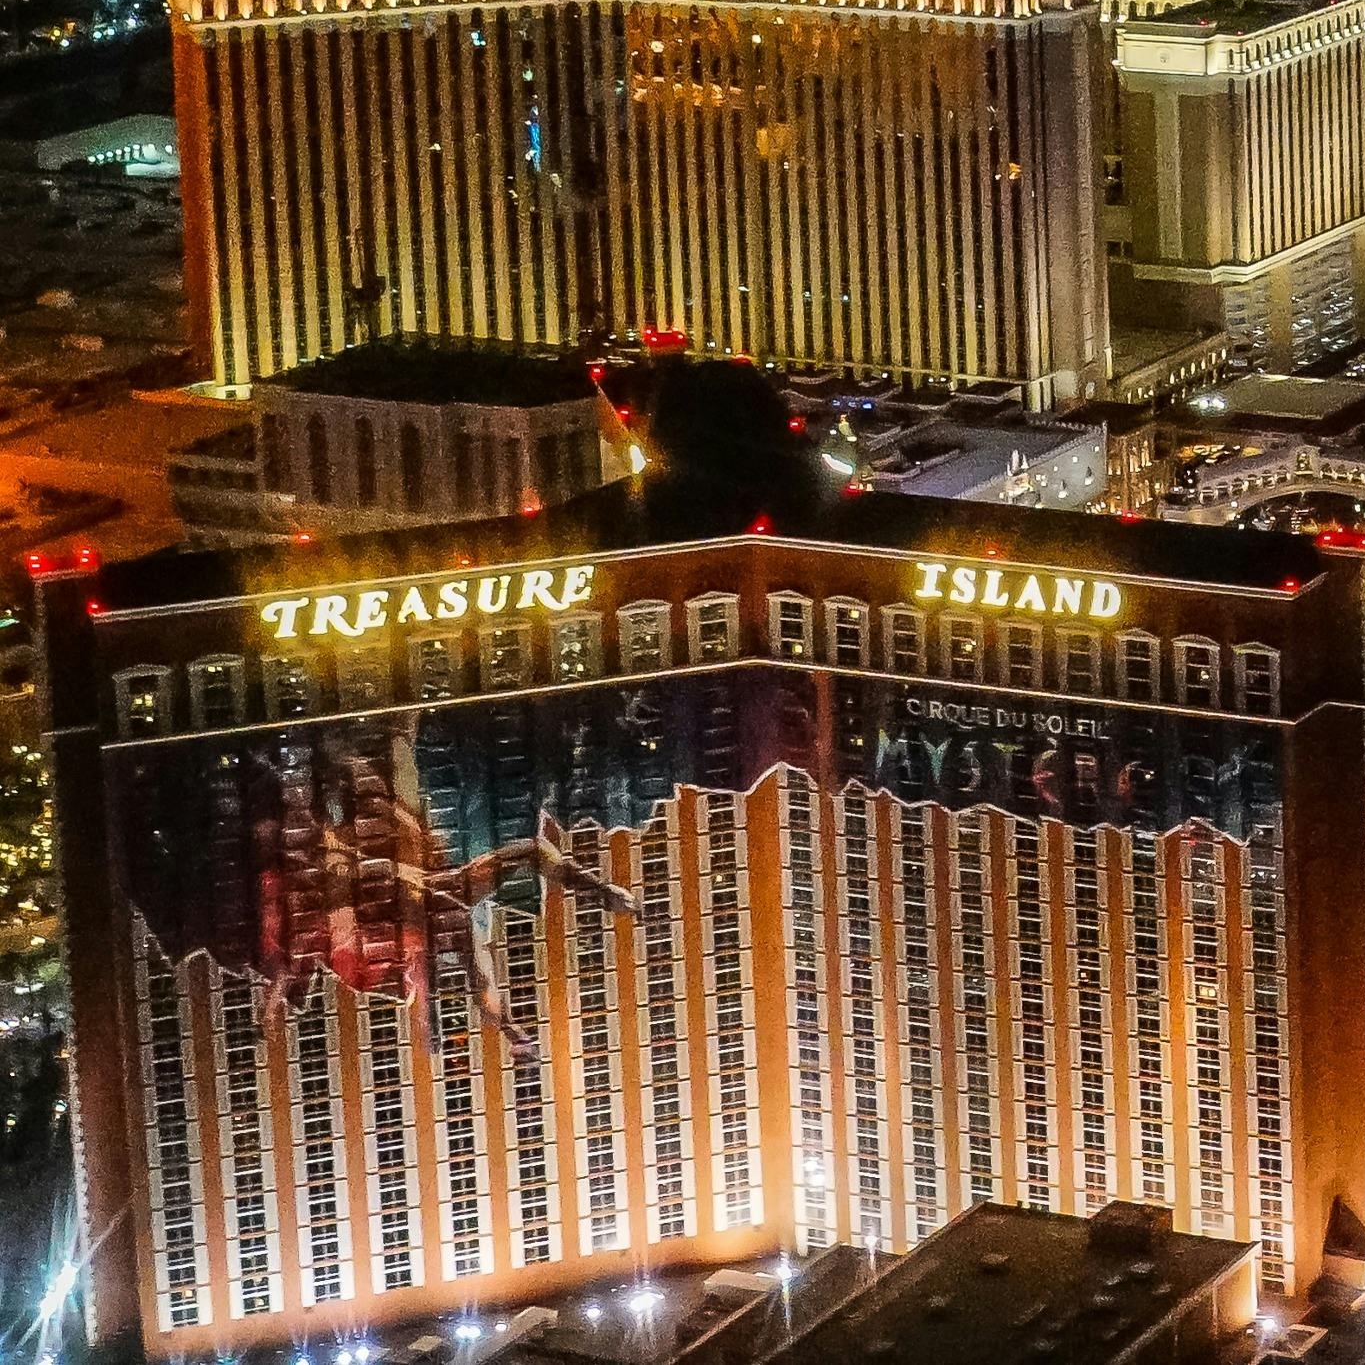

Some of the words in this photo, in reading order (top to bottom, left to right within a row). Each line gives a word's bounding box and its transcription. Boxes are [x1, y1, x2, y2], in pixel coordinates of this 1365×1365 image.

[260, 564, 596, 639] TREASURE
[914, 562, 1122, 618] ISLAND
[906, 698, 990, 729] CIRQUE
[996, 708, 1027, 728] DU
